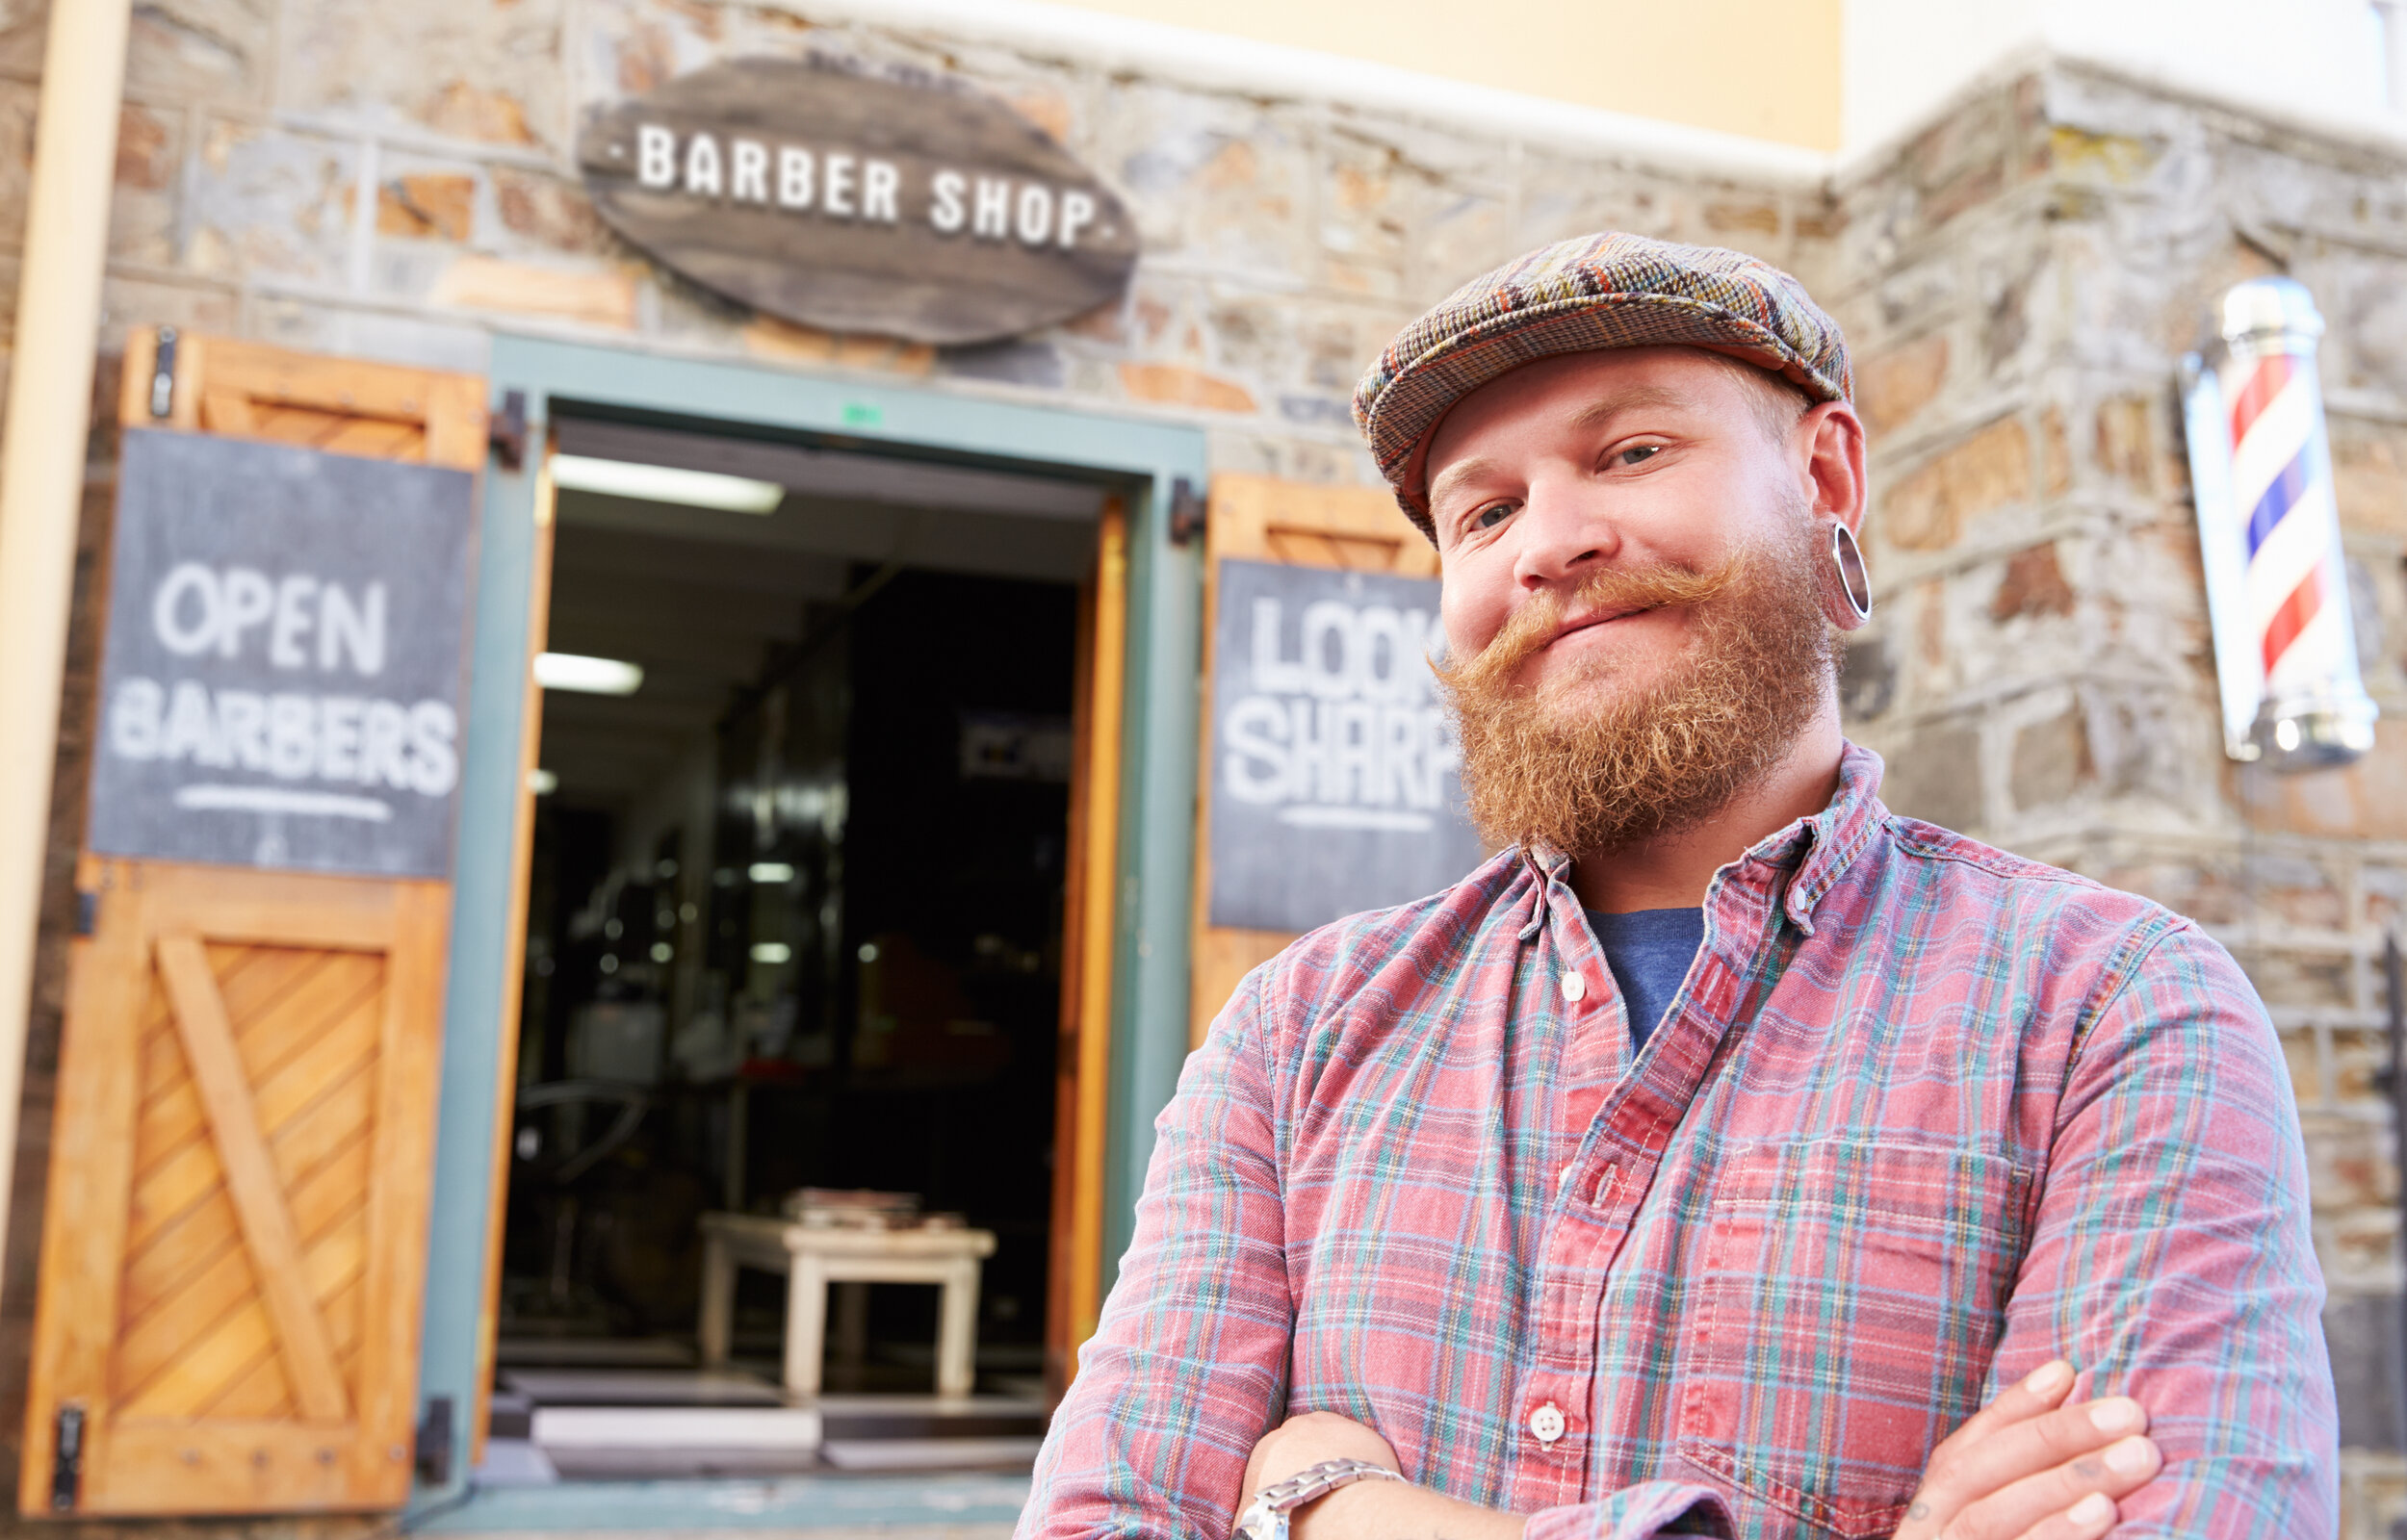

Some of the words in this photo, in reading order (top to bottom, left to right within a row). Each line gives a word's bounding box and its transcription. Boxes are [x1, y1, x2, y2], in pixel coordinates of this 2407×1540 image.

[638, 125, 899, 221] BARBER
[930, 170, 1096, 248] SHOP
[154, 563, 385, 673] OPEN
[111, 680, 457, 796] BARBERS
